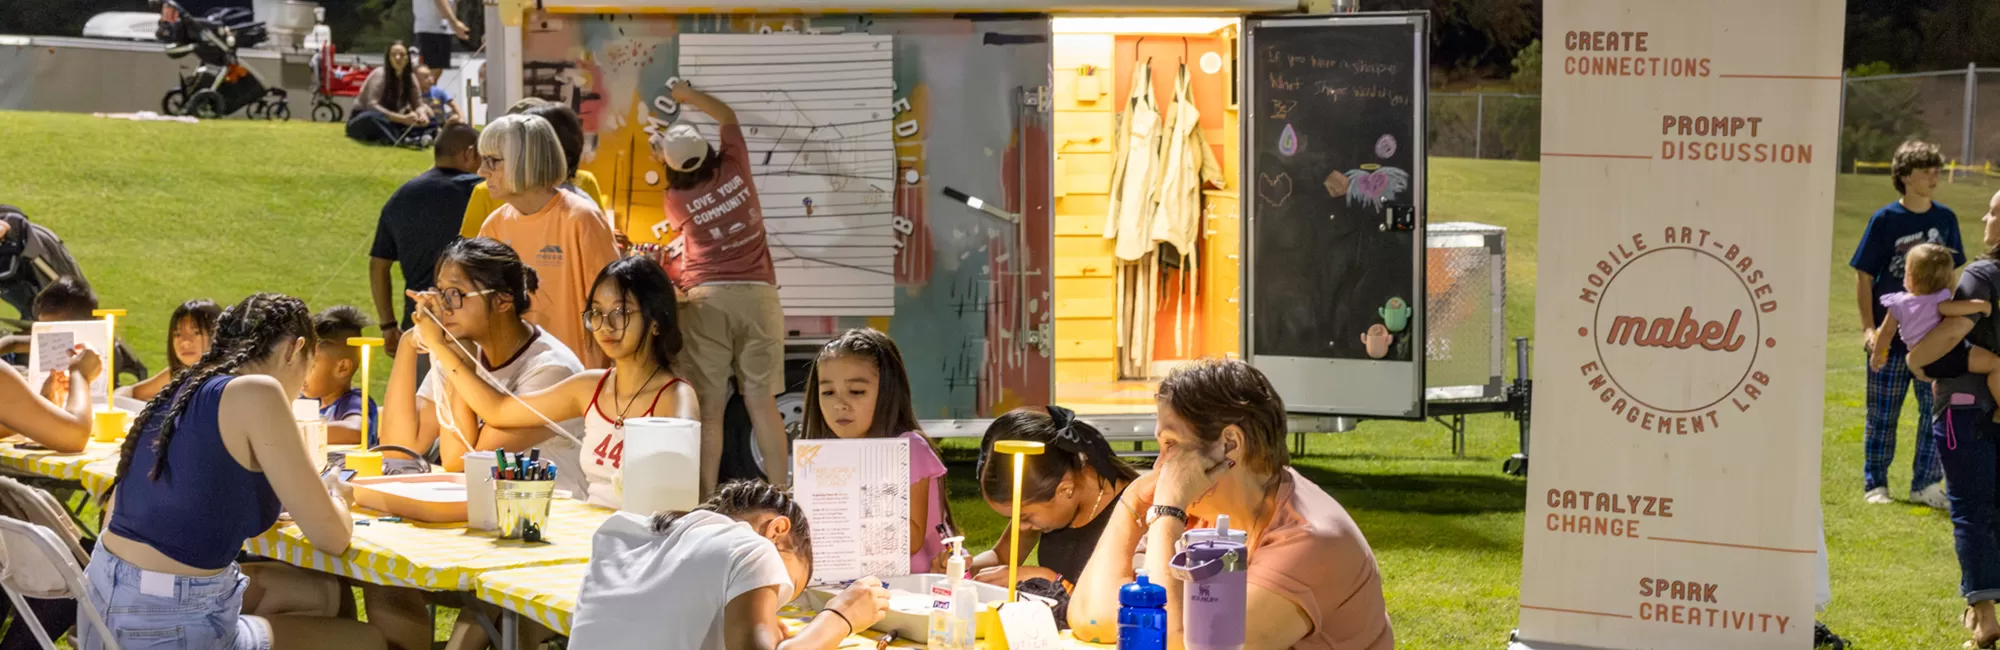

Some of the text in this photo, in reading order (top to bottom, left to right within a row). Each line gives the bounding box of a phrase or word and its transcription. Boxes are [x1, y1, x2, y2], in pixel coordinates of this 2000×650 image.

[1565, 31, 1648, 51] CREATE
[1564, 56, 1711, 77] CONNECTIONS
[1662, 115, 1762, 137] PROMPT
[1661, 140, 1813, 164] DISCUSSION
[686, 175, 744, 213] LOVE YOUR
[693, 187, 751, 225] COMMUNITY
[1579, 226, 1778, 313] MOBILE ART-BASED
[1606, 306, 1746, 352] mabel
[1580, 361, 1770, 435] ENGAGEMENT LAB
[594, 433, 624, 469] 44
[1546, 488, 1674, 518] CATALYZE
[1546, 513, 1640, 538] CHANGE
[1639, 577, 1718, 604] SPARK
[1639, 602, 1790, 634] CREATIVITY
